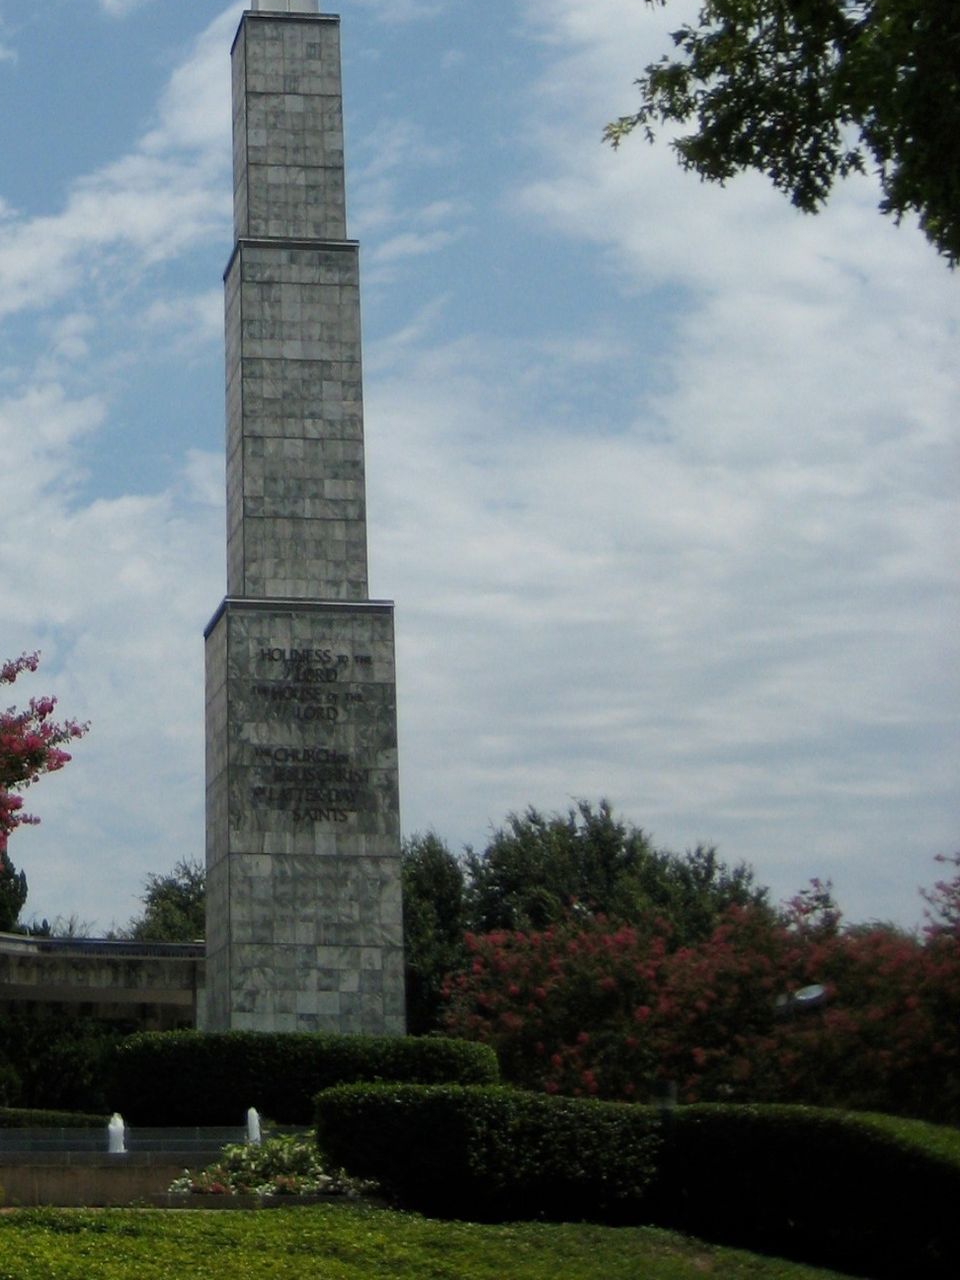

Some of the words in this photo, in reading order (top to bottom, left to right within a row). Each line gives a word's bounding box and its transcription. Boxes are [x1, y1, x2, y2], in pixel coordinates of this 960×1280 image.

[260, 648, 333, 663] HOLINESS
[294, 666, 338, 683] LORD
[271, 686, 321, 702] HOUSE
[294, 705, 339, 722] LORD
[273, 748, 337, 763] CHURCH
[292, 807, 349, 824] SAINTS
